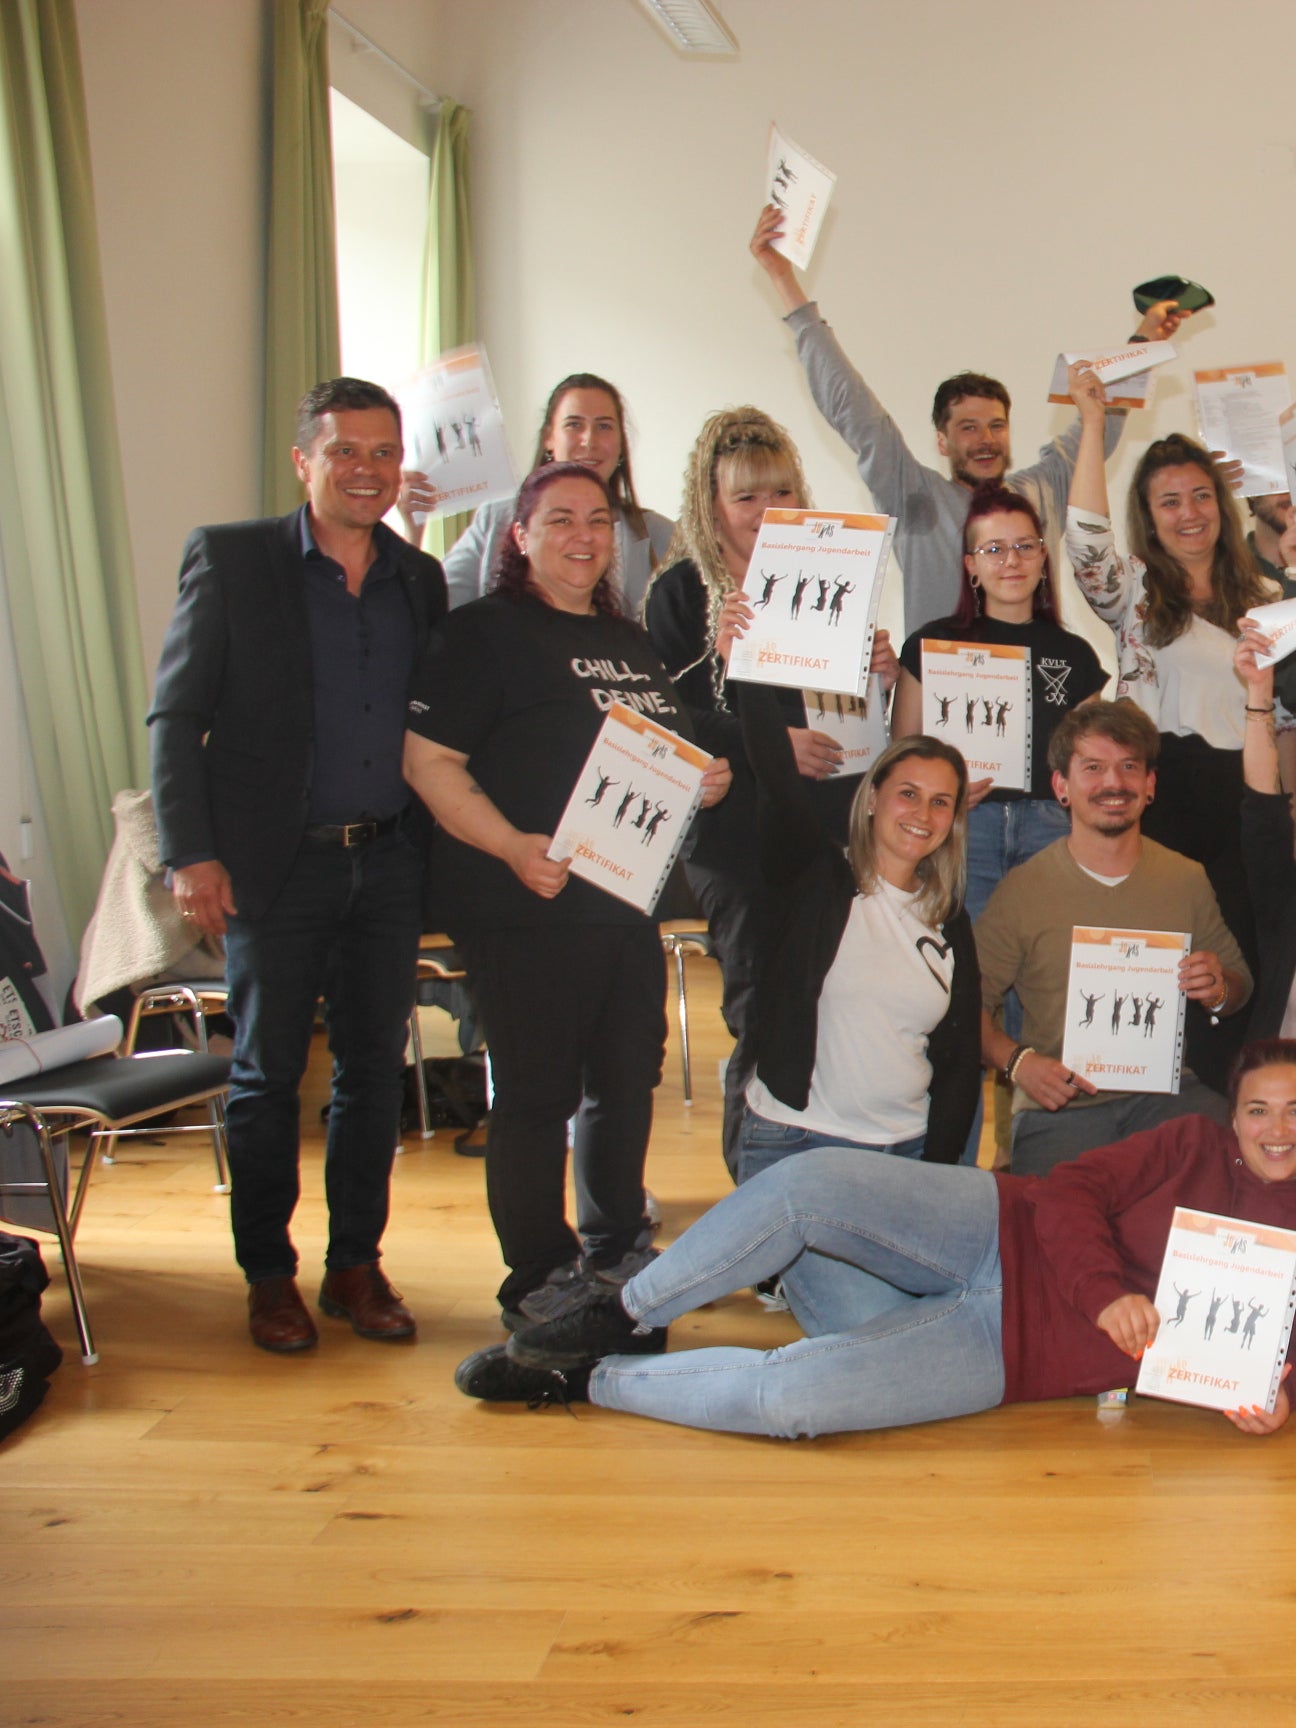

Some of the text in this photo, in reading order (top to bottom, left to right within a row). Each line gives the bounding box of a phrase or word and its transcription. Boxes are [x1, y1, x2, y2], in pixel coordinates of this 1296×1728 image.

[761, 541, 872, 558] Basislehrgang Jugendarbeit
[757, 650, 831, 671] ZERTIFIKAT
[603, 736, 649, 770] Basislehrgang
[965, 758, 1003, 772] TIFIKAT
[575, 843, 635, 881] ZERTIFIKAT
[1075, 961, 1174, 975] Basislehrgang Jugendarbeit
[1085, 1062, 1148, 1076] ZERTIFIKAT
[1172, 1249, 1285, 1281] Basislehrgang Jugendarbeit
[1167, 1367, 1240, 1392] ZERTIFIKAT
